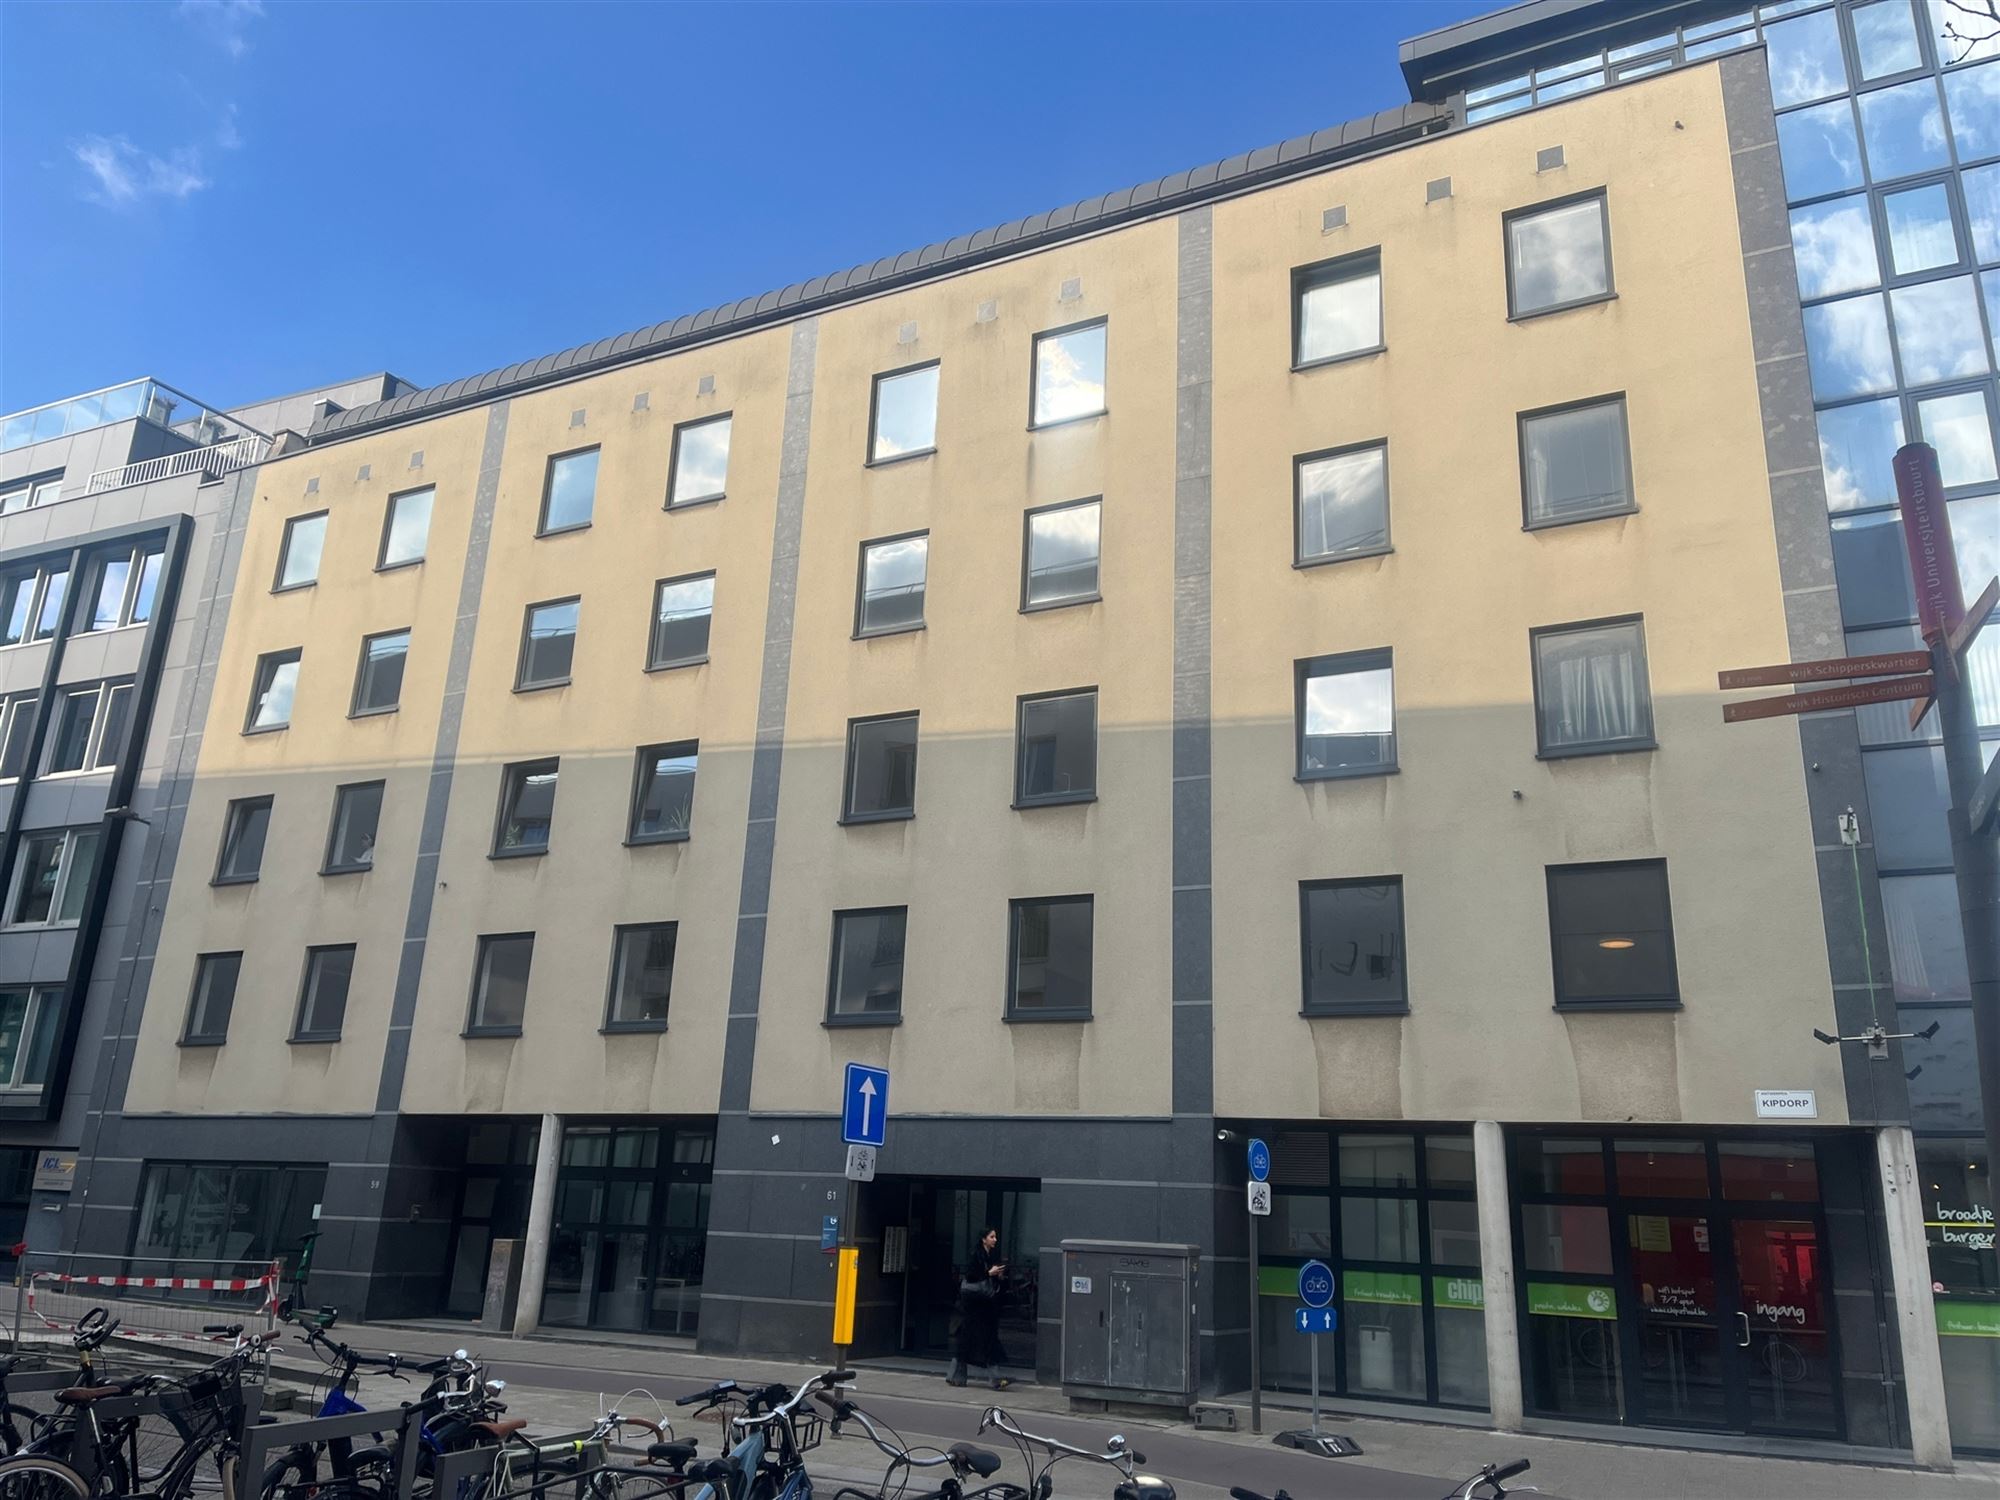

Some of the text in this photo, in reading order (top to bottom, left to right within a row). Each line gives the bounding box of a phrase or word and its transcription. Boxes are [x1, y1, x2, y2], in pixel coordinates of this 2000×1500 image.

[1789, 657, 1920, 679] wijk Schipperskwartier
[1786, 681, 1923, 710] wijk Historisch Centrum
[1762, 1099, 1809, 1108] KIPDORP
[826, 1190, 837, 1201] 61
[1936, 1201, 1995, 1225] broodje
[1942, 1226, 1996, 1250] burger
[1660, 1294, 1678, 1304] 7/7
[1755, 1300, 1806, 1325] ingang
